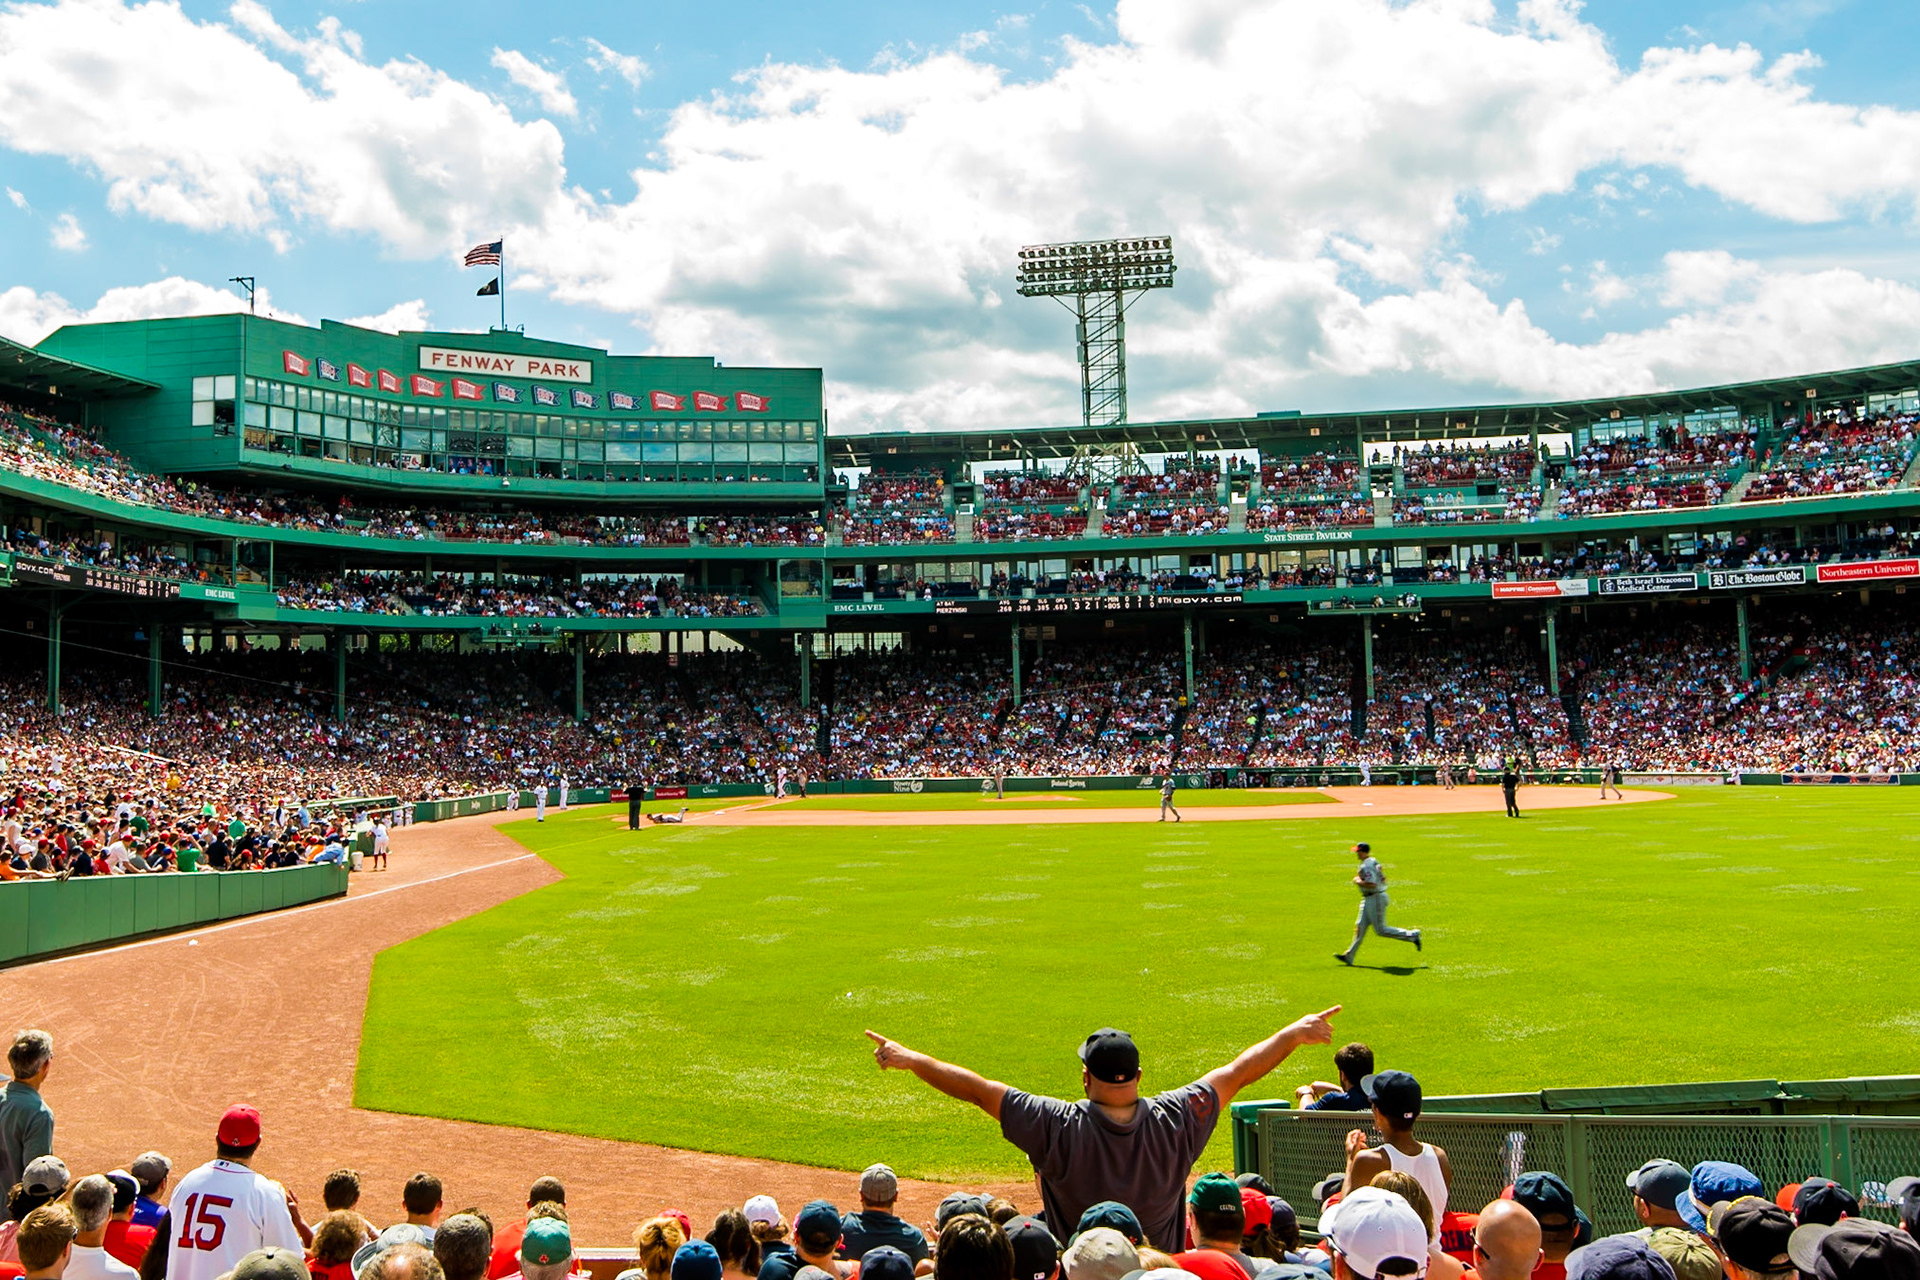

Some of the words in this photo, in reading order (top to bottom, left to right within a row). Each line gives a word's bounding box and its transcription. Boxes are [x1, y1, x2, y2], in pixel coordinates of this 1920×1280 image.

[432, 352, 514, 372] FENWAY
[528, 361, 580, 378] PARK
[1264, 534, 1286, 542] STATE
[1287, 532, 1314, 542] STREET
[1316, 532, 1352, 540] PAVILION
[1822, 568, 1872, 578] Northeastern
[1874, 564, 1916, 574] University
[1713, 574, 1724, 586] B
[1728, 574, 1744, 584] The
[1744, 573, 1776, 583] Boston
[1776, 571, 1800, 582] Globe
[122, 582, 126, 592] 3
[126, 583, 130, 593] 2
[1074, 602, 1080, 610] 3
[1085, 602, 1090, 610] 2
[1096, 602, 1099, 610] 1
[178, 1192, 234, 1251] 15
